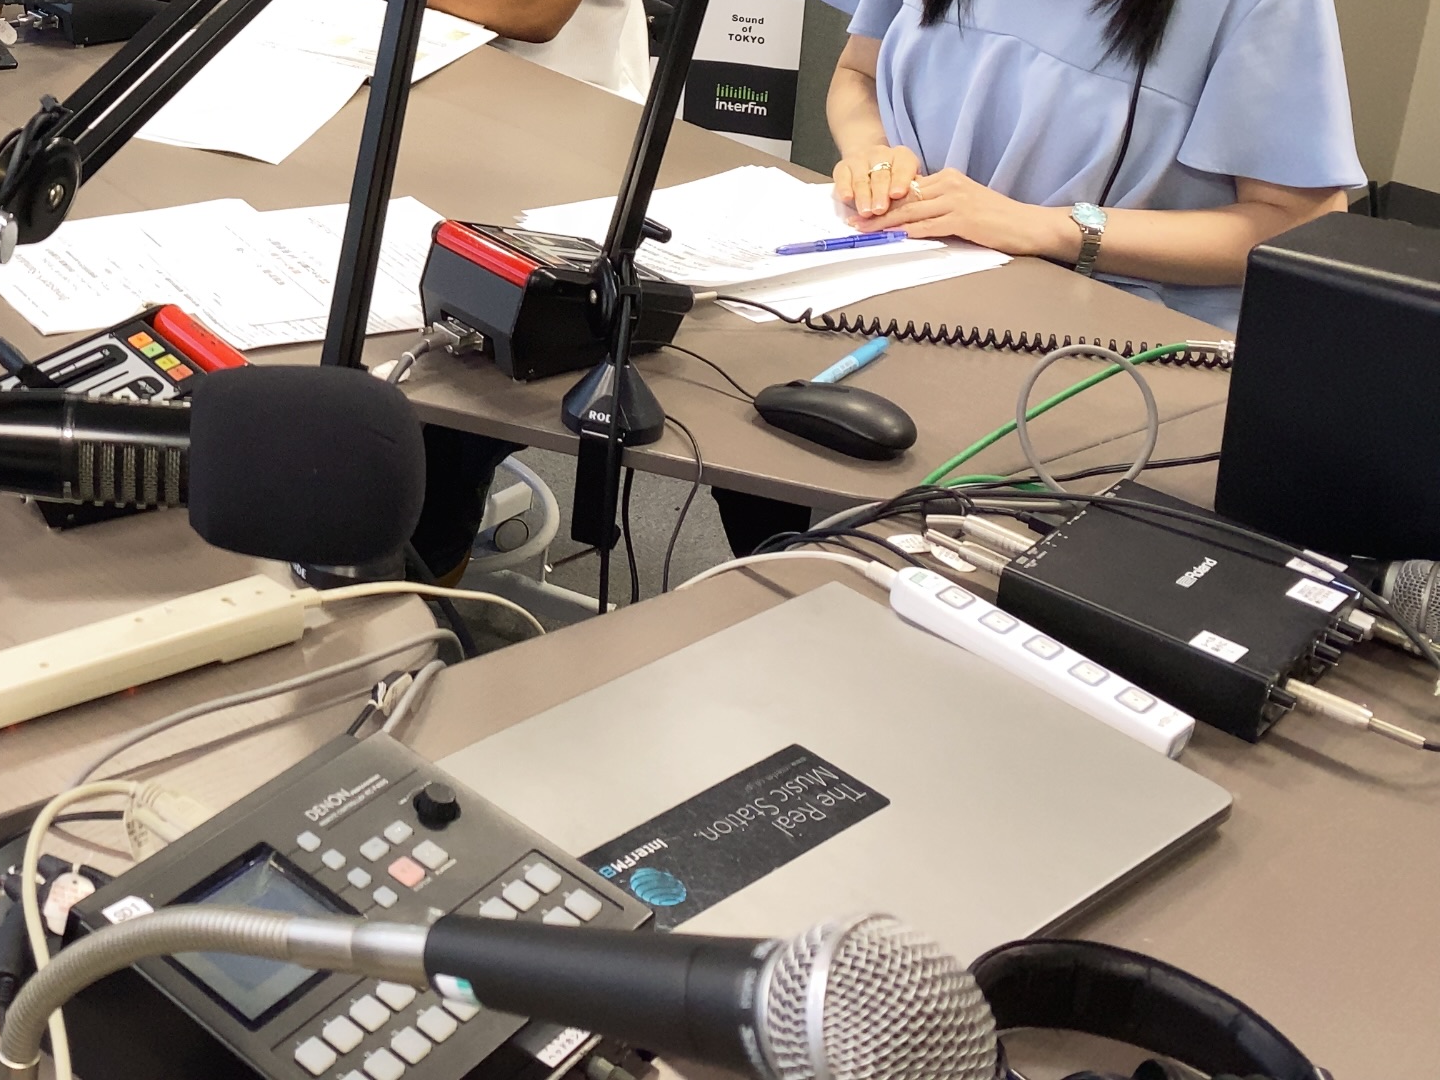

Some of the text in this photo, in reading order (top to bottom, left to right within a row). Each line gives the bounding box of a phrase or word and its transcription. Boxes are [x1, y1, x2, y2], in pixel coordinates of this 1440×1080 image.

[731, 14, 764, 25] Sound
[742, 25, 752, 33] of
[728, 33, 765, 44] TOKYO
[715, 98, 768, 116] interfm
[589, 410, 611, 423] ROD
[1180, 556, 1218, 583] Roland
[770, 765, 839, 803] Music
[305, 788, 351, 821] DENON
[772, 783, 867, 838] The Real
[693, 797, 780, 841] Station.
